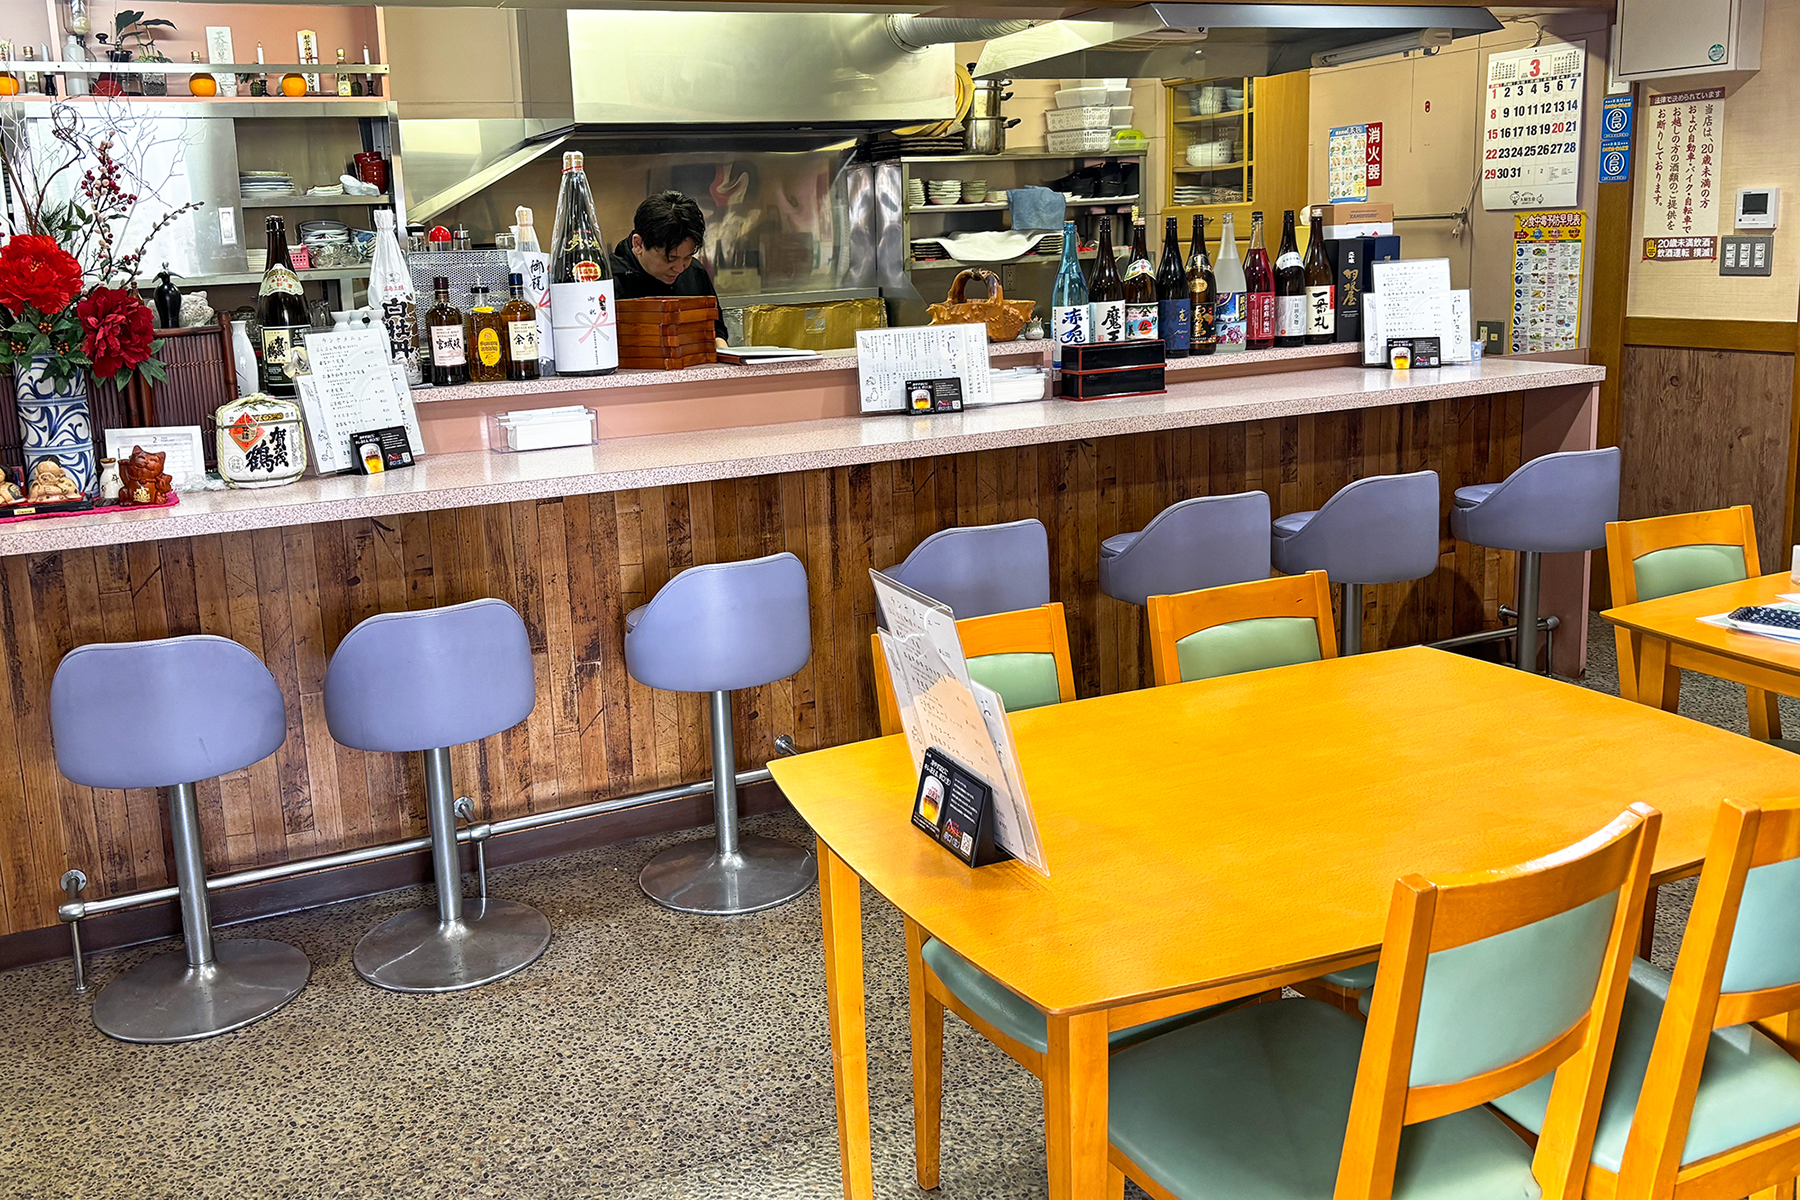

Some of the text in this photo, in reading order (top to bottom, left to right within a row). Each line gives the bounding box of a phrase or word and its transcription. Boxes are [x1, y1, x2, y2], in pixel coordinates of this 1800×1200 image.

[1530, 59, 1540, 76] 3
[1492, 89, 1496, 99] 1
[1504, 87, 1510, 97] 2
[1517, 86, 1523, 96] 3
[1531, 84, 1537, 94] 4
[1544, 82, 1550, 92] 5
[1557, 80, 1563, 91] 6
[1571, 79, 1577, 89] 7
[1654, 90, 1722, 105] 法律で決められています
[1490, 100, 1578, 119] 8 9 10 11 12 13 14
[1487, 121, 1576, 139] 15 16 17 18 19 20 21
[1368, 127, 1380, 180] 消火器
[1486, 142, 1576, 160] 22 23 24 25 26 27 28
[1652, 108, 1667, 207] お断りしております。
[1699, 103, 1715, 209] 当店は、20歳未満の方
[1485, 169, 1496, 180] 29
[1497, 168, 1508, 178] 30
[1510, 167, 1521, 177] 31
[1666, 107, 1683, 231] お越しの方の酒類のご提供を
[1681, 104, 1697, 234] および自動車・バイク・自転車で
[1657, 248, 1690, 258] 飲酒運転
[1101, 306, 1122, 341] 魔王
[1312, 291, 1329, 330] 一番札
[382, 297, 415, 359] 白牡丹
[514, 332, 535, 345] 余市
[245, 426, 289, 473] 賀茂鶴
